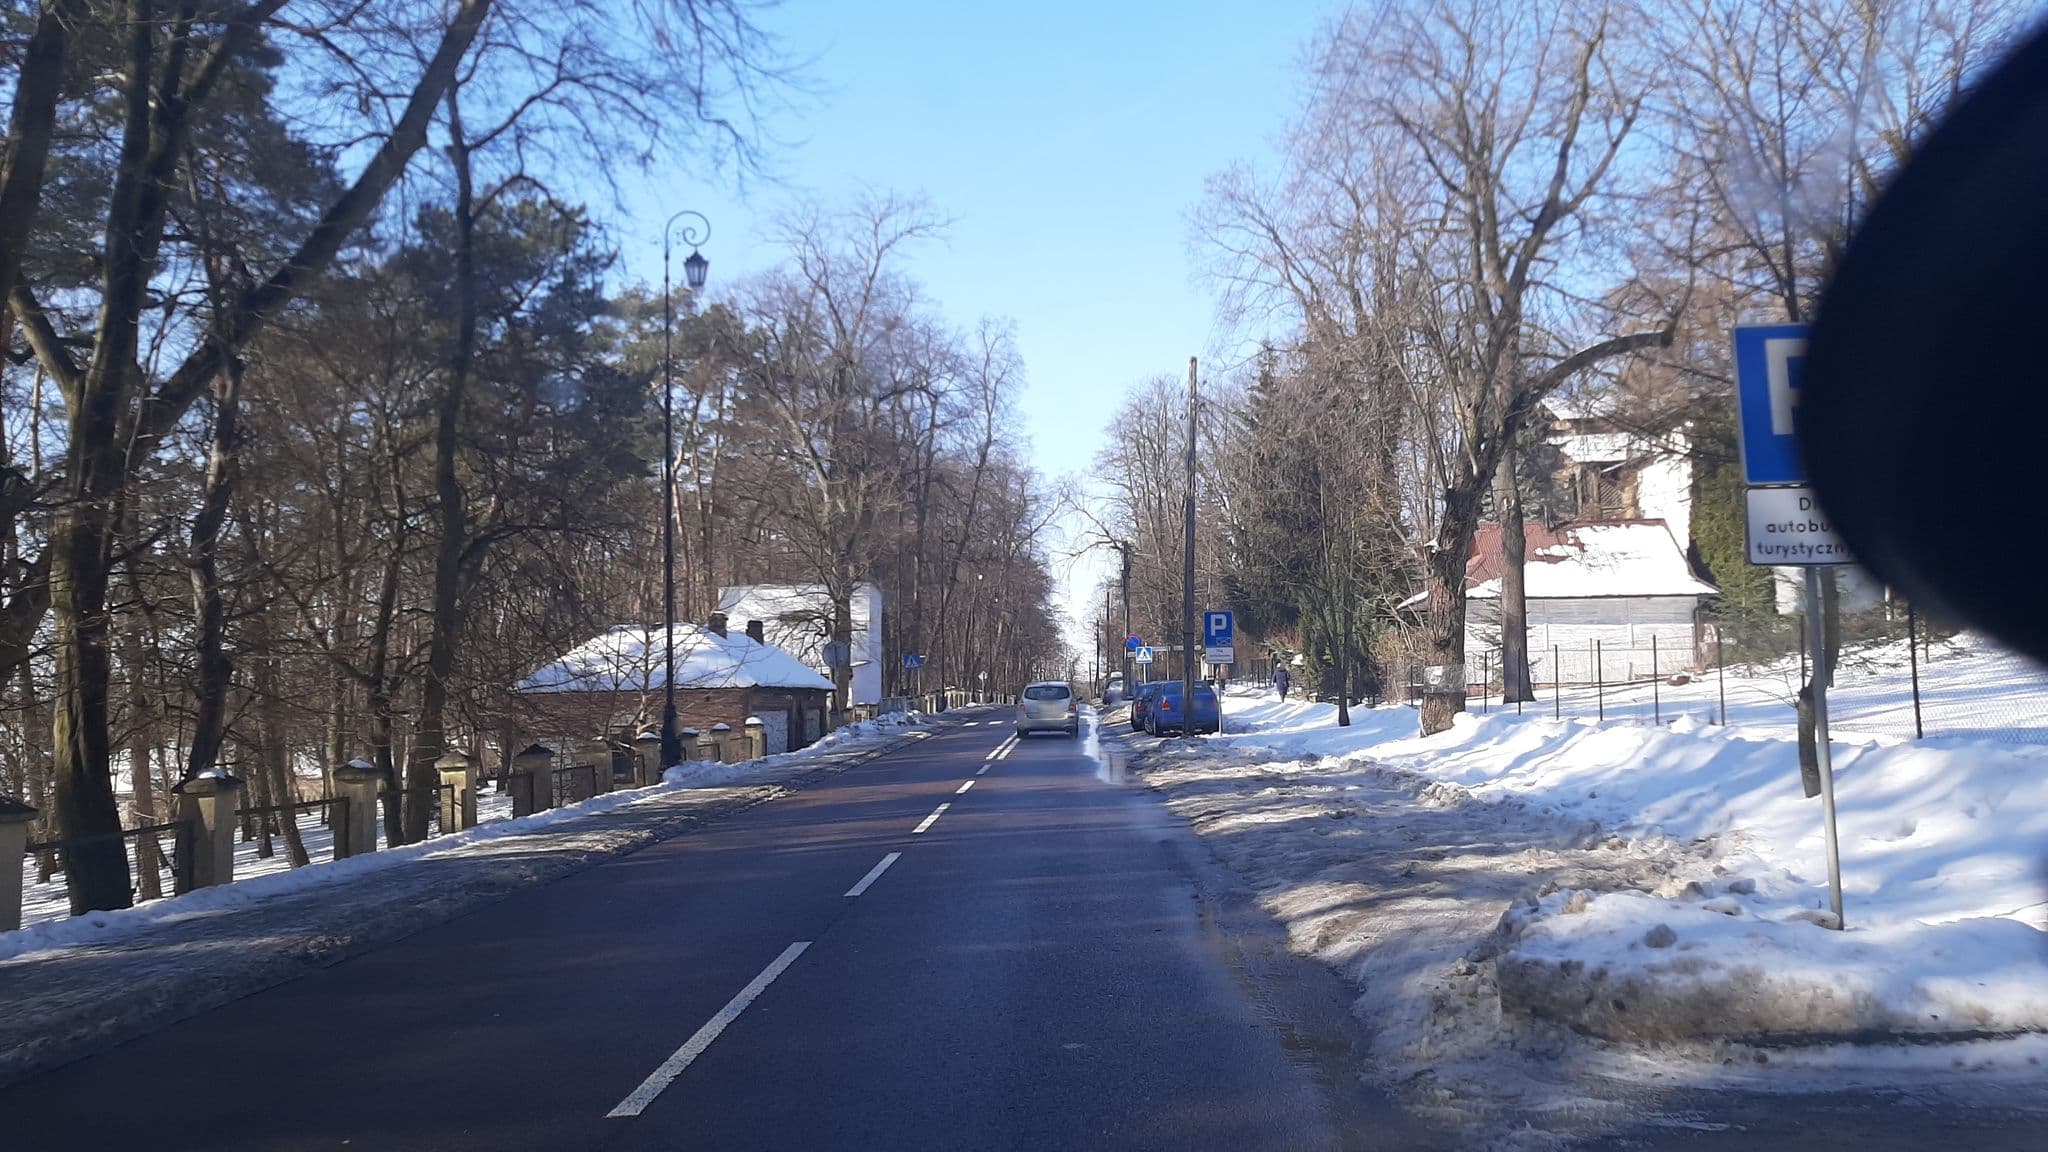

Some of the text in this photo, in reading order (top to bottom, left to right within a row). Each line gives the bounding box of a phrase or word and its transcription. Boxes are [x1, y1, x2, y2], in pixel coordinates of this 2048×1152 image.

[1799, 497, 1817, 511] Dl
[1766, 519, 1832, 533] autobu
[1757, 541, 1849, 559] turystyczn
[1210, 614, 1227, 636] P
